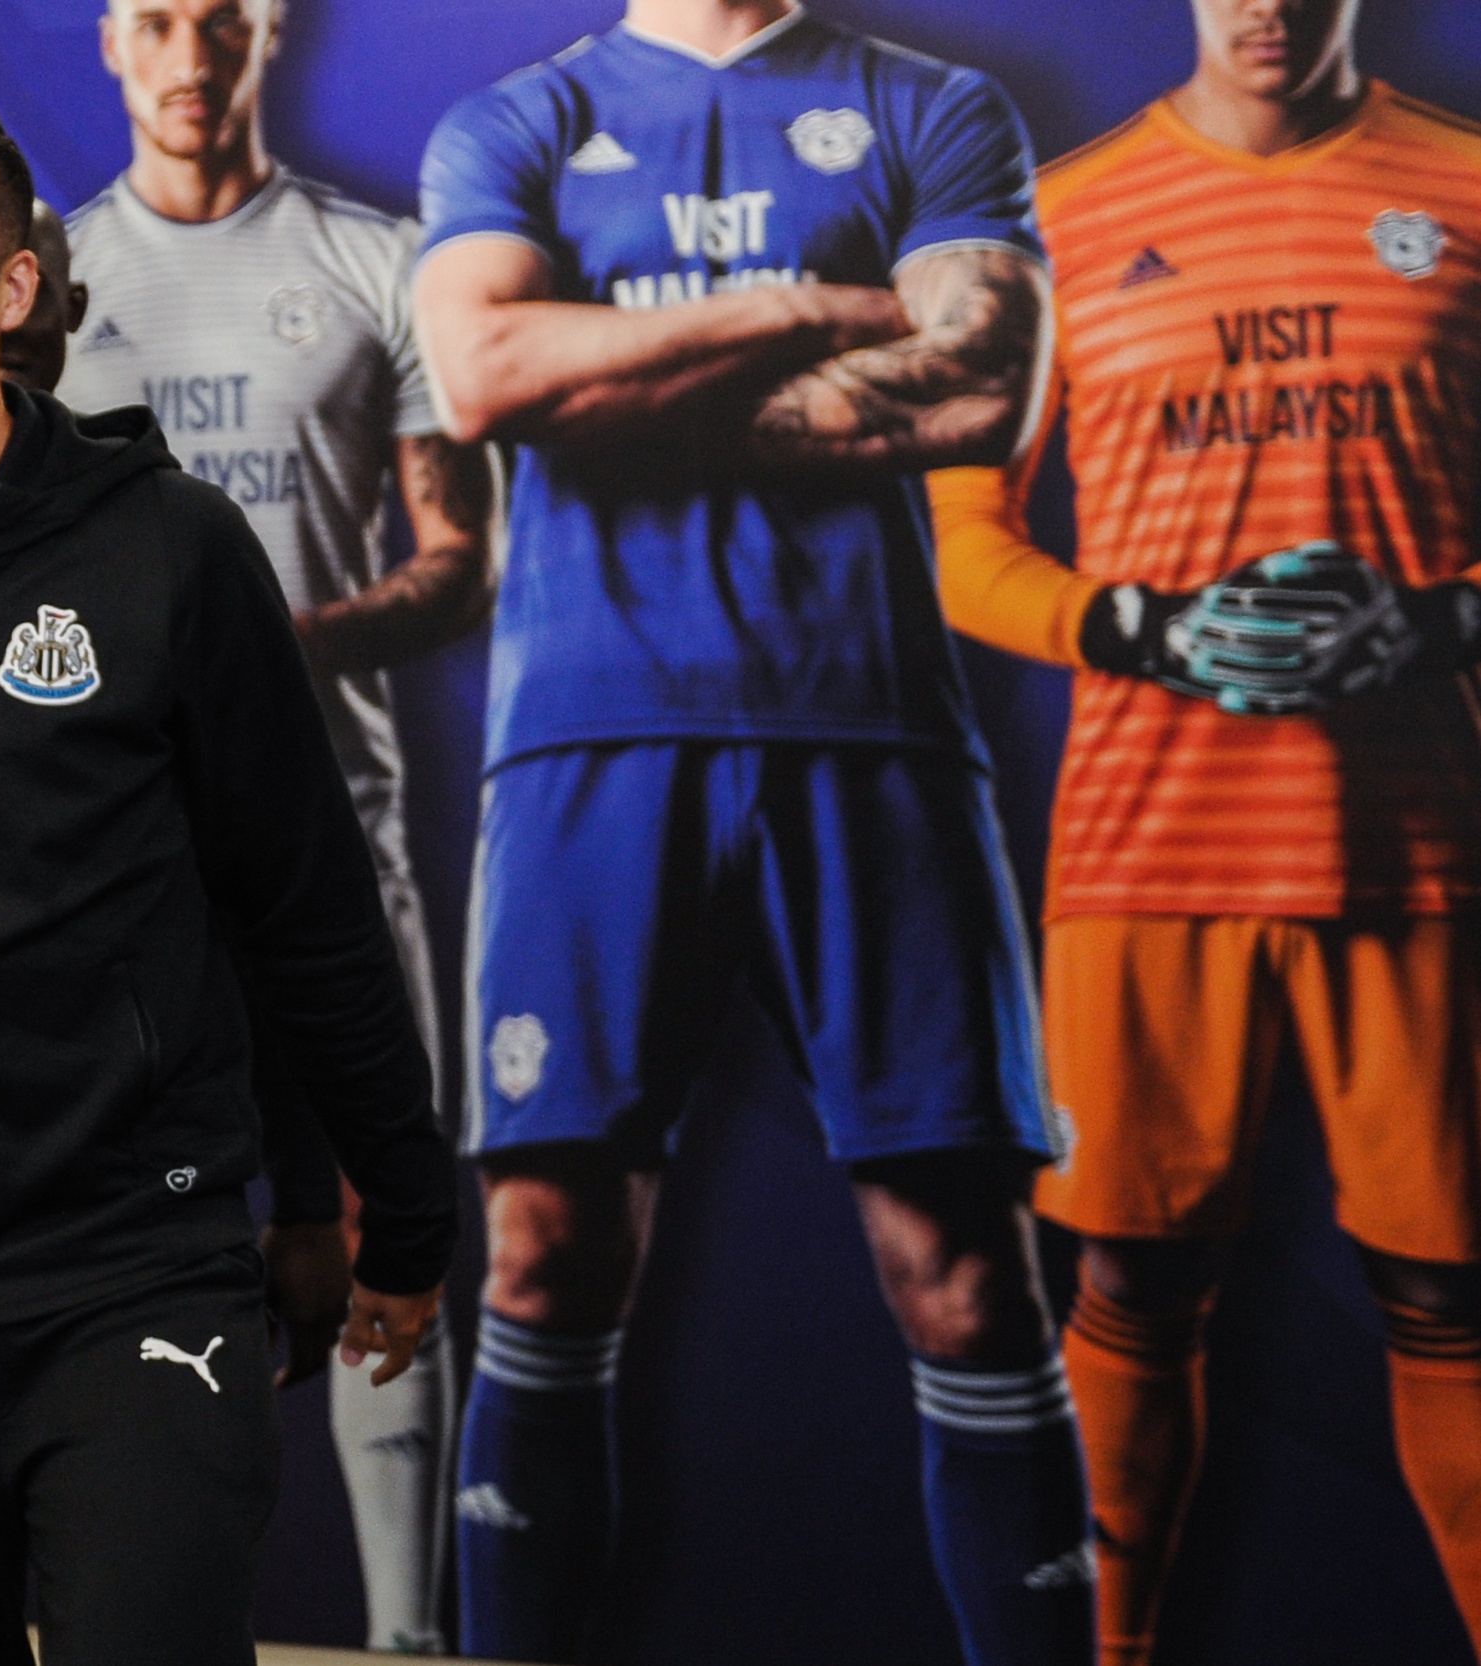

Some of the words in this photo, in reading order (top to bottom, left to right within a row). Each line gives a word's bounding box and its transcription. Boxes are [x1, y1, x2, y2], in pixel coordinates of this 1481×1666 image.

[1215, 304, 1339, 364] VISIT
[143, 373, 249, 431] VISIT
[1163, 377, 1394, 448] MALAYSIA
